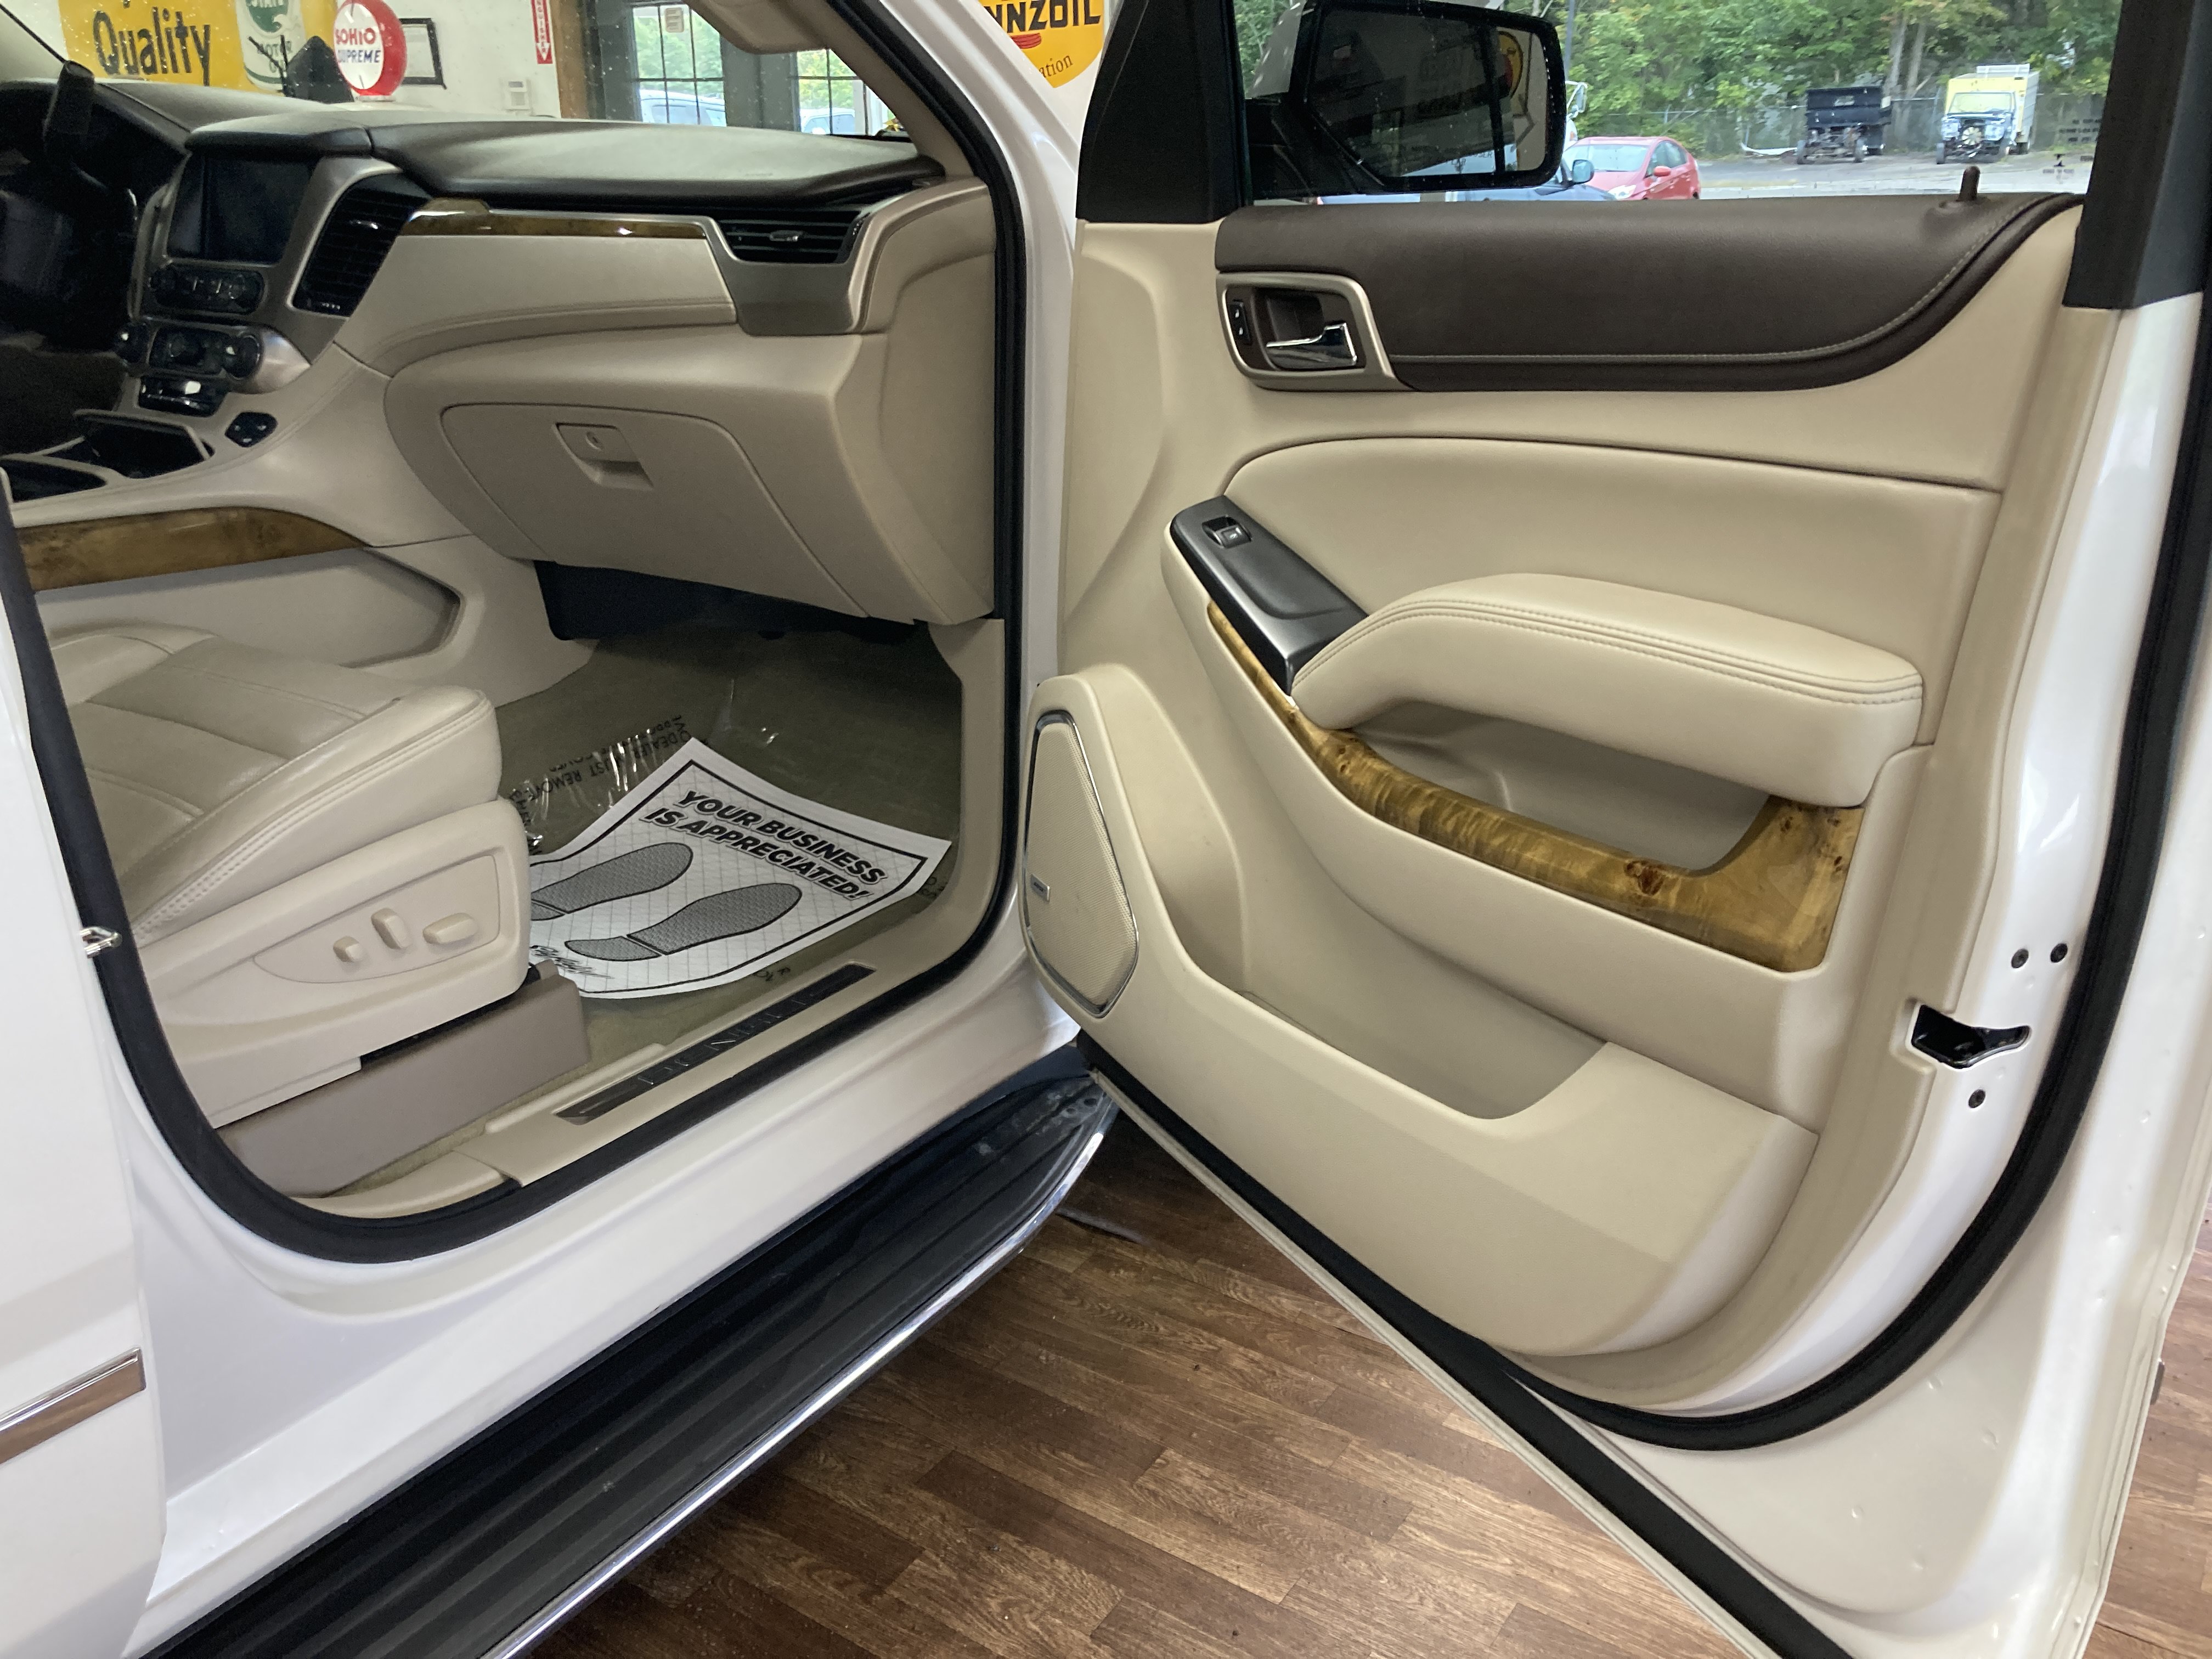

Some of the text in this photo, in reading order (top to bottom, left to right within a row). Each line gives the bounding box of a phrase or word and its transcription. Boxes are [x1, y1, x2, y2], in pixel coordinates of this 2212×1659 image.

[92, 6, 210, 87] Quality
[335, 27, 376, 44] SOHIO
[338, 50, 381, 63] SUPREME
[644, 808, 685, 828] IS
[678, 820, 870, 899] APPRECIATED!
[678, 791, 885, 883] YOUR BUSINESS
